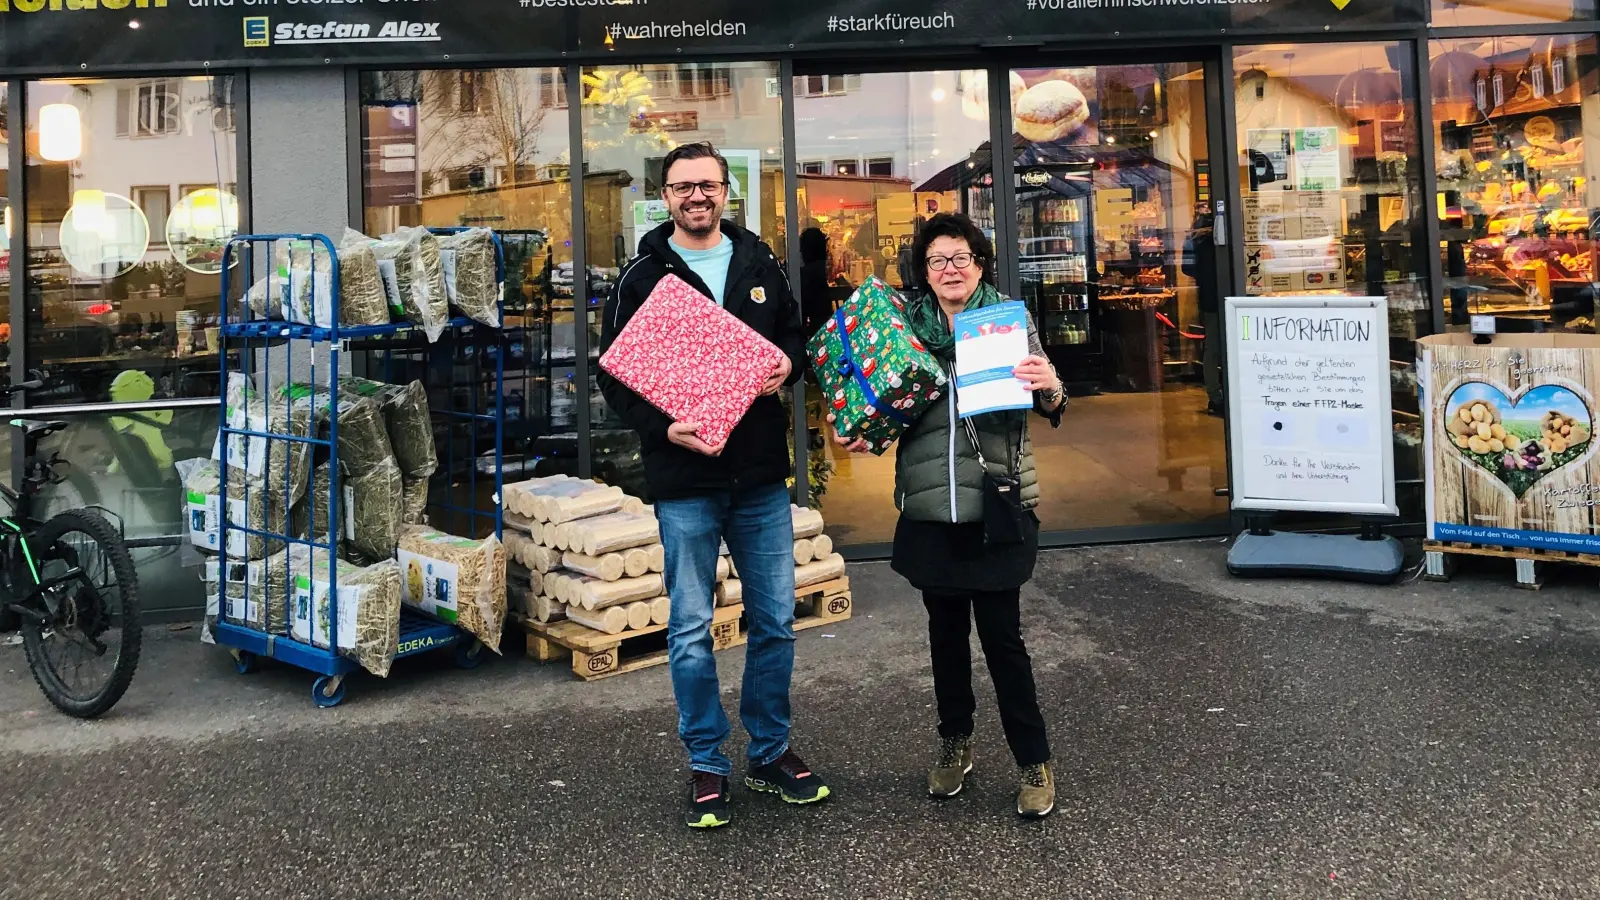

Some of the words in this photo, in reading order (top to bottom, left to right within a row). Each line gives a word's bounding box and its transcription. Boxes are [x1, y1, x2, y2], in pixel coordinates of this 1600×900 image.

[274, 21, 370, 39] Stefan
[377, 21, 440, 38] Alex
[610, 20, 746, 39] #wahrehelden
[827, 12, 955, 32] #starkfüreuch
[1256, 317, 1370, 342] INFORMATION
[1295, 356, 1310, 367] der
[1316, 357, 1355, 373] geltenden
[1450, 360, 1481, 369] HERZ
[1508, 356, 1525, 366] Sie
[1257, 374, 1306, 384] gesetzlichen
[1312, 371, 1366, 386] Bestimmungen
[1268, 384, 1291, 393] bitten
[1316, 385, 1331, 393] Sie
[1261, 396, 1287, 411] Tragen
[1292, 399, 1311, 408] einer
[1263, 455, 1288, 466] Danke
[1292, 457, 1301, 468] für
[1307, 458, 1316, 468] Ihr
[1439, 527, 1457, 535] Vom
[1458, 528, 1473, 536] Feld
[1474, 530, 1486, 538] auf
[1502, 532, 1520, 540] Tisch
[1560, 537, 1584, 545] immer
[831, 599, 847, 612] EPAL
[397, 635, 434, 654] EDEKA
[591, 654, 610, 669] EPAL
